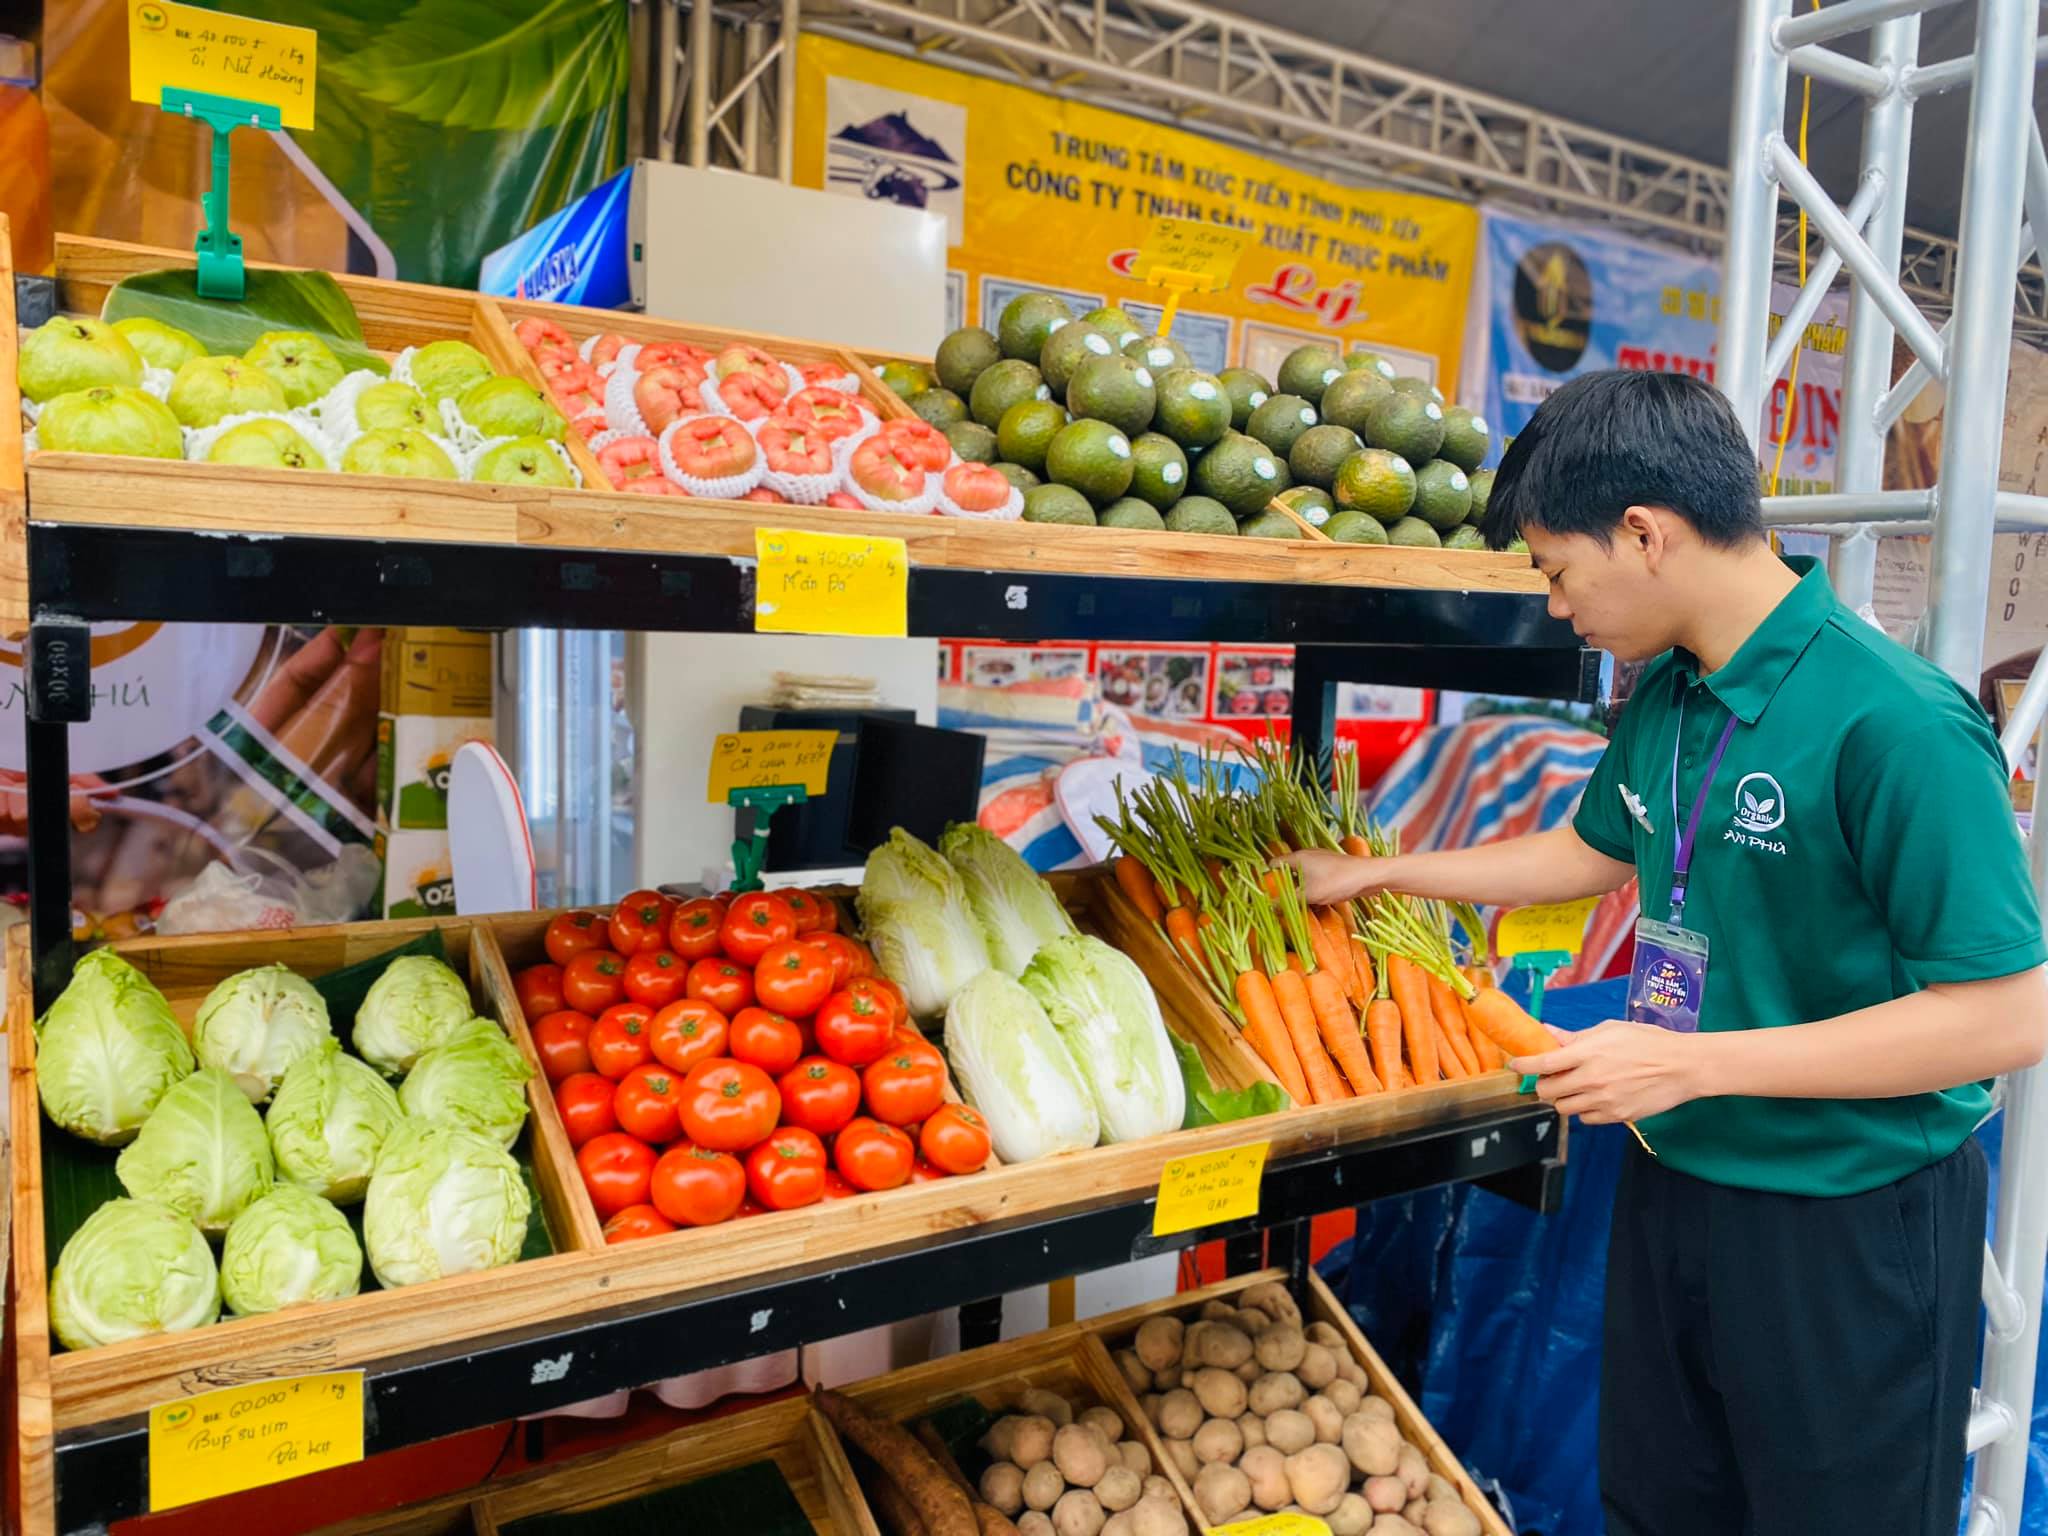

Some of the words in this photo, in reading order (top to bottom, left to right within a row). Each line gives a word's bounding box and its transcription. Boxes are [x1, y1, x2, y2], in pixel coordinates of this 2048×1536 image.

[1051, 129, 1130, 170] TRUNG
[1006, 157, 1081, 202] CÔNG
[1091, 180, 1124, 210] TY
[89, 675, 151, 708] HÚ
[1740, 807, 1774, 824] Organic
[1723, 829, 1746, 845] AN
